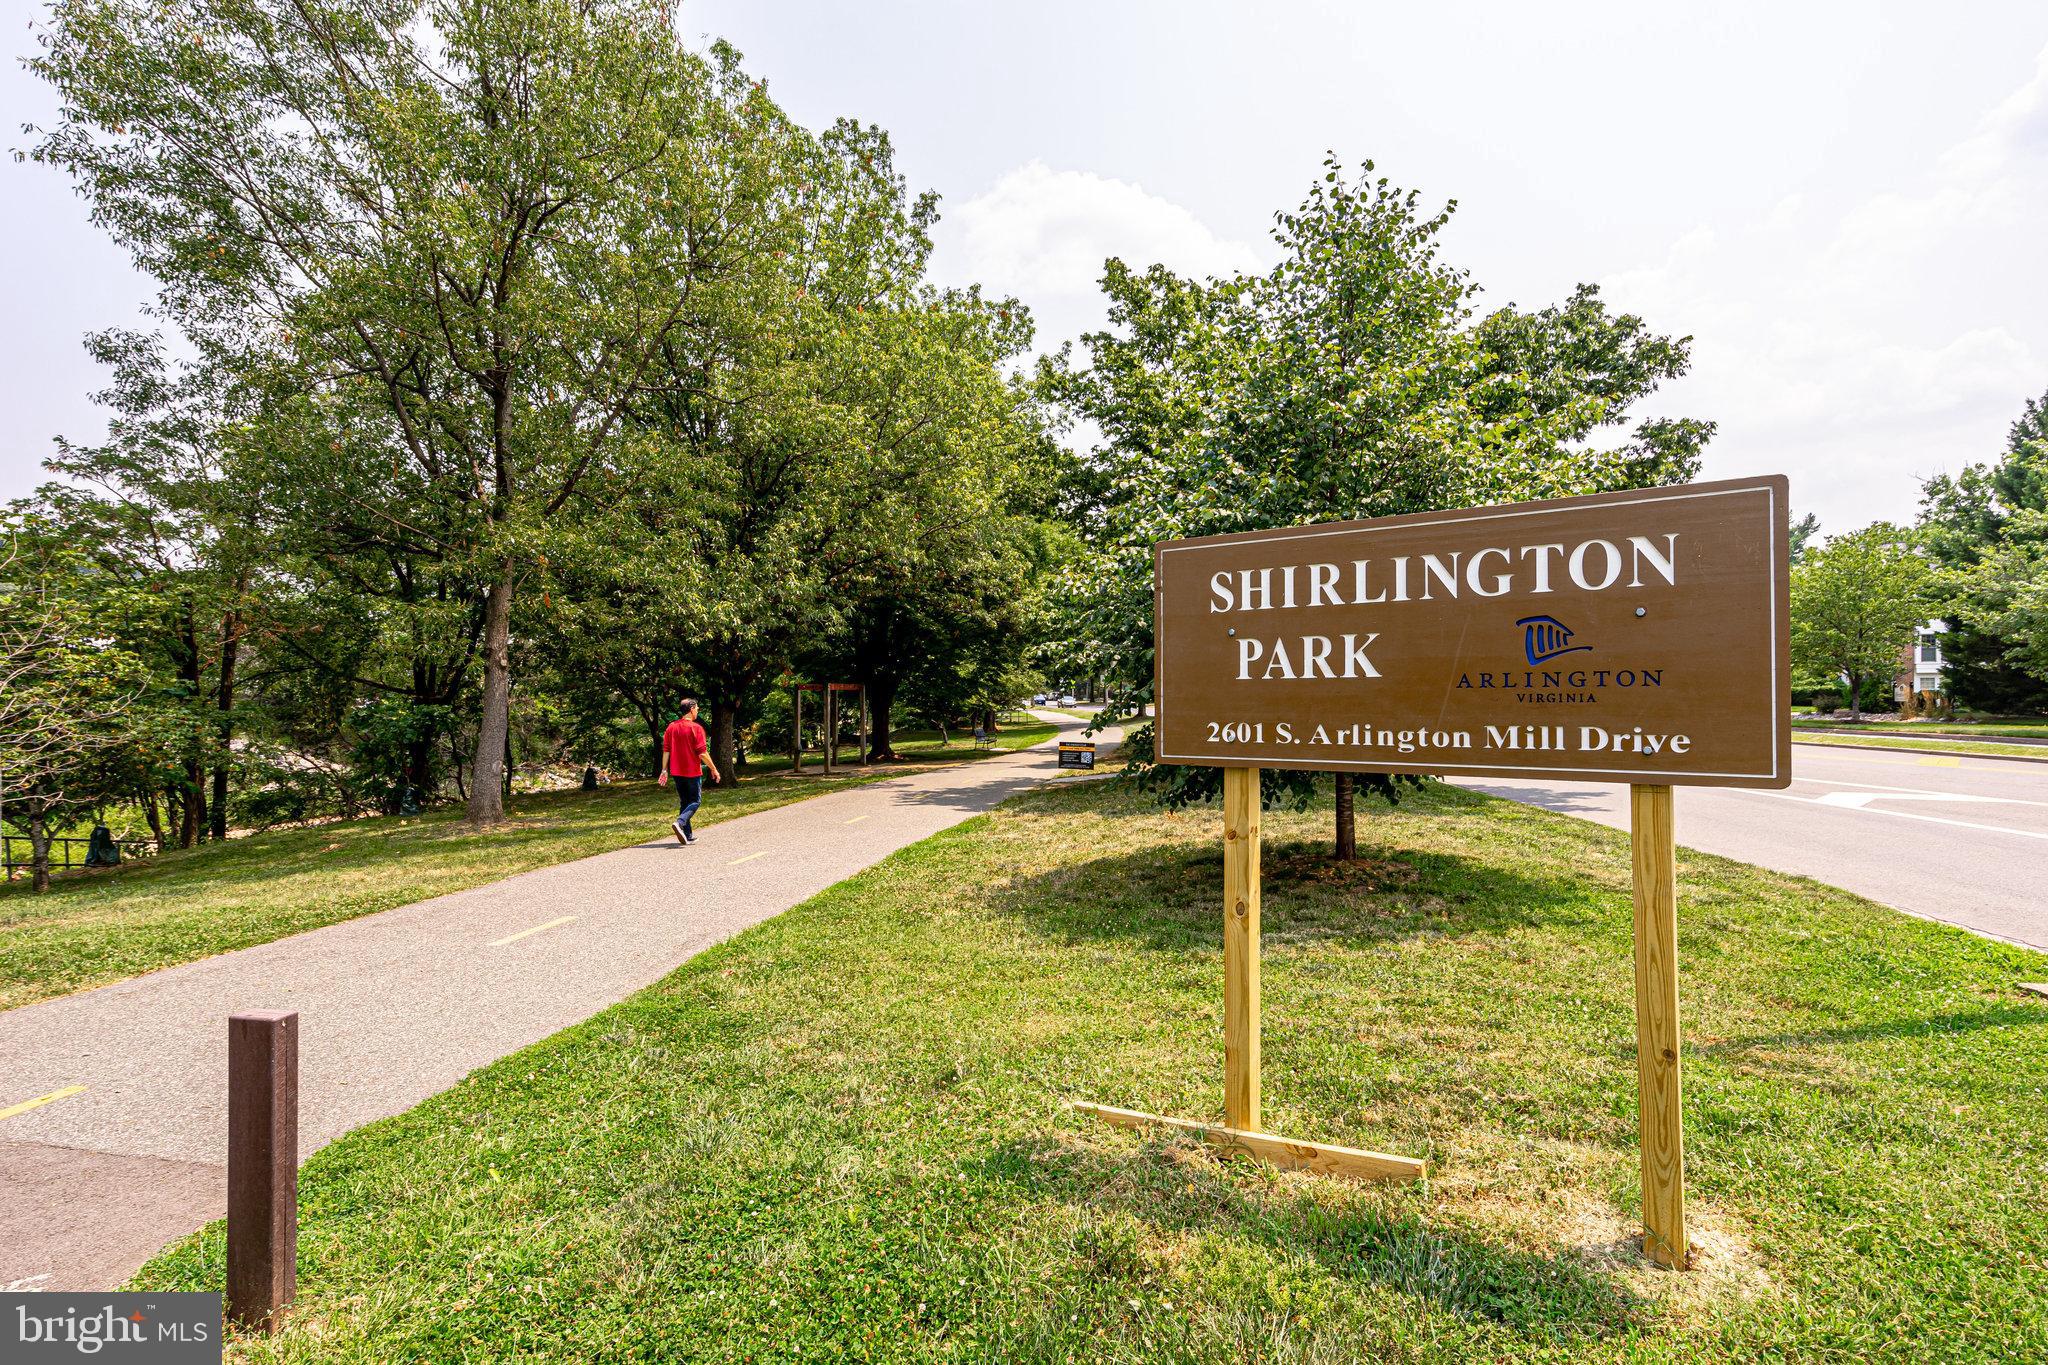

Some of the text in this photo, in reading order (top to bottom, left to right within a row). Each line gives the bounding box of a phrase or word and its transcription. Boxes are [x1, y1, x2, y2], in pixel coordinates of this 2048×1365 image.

[1210, 532, 1680, 614] SHIRLINGTON
[1236, 632, 1382, 681] PARK
[1456, 669, 1663, 689] ARLINGTON
[1517, 693, 1597, 703] VIRGINIA
[1206, 721, 1691, 754] 2601 S. Arlington Mill Drive
